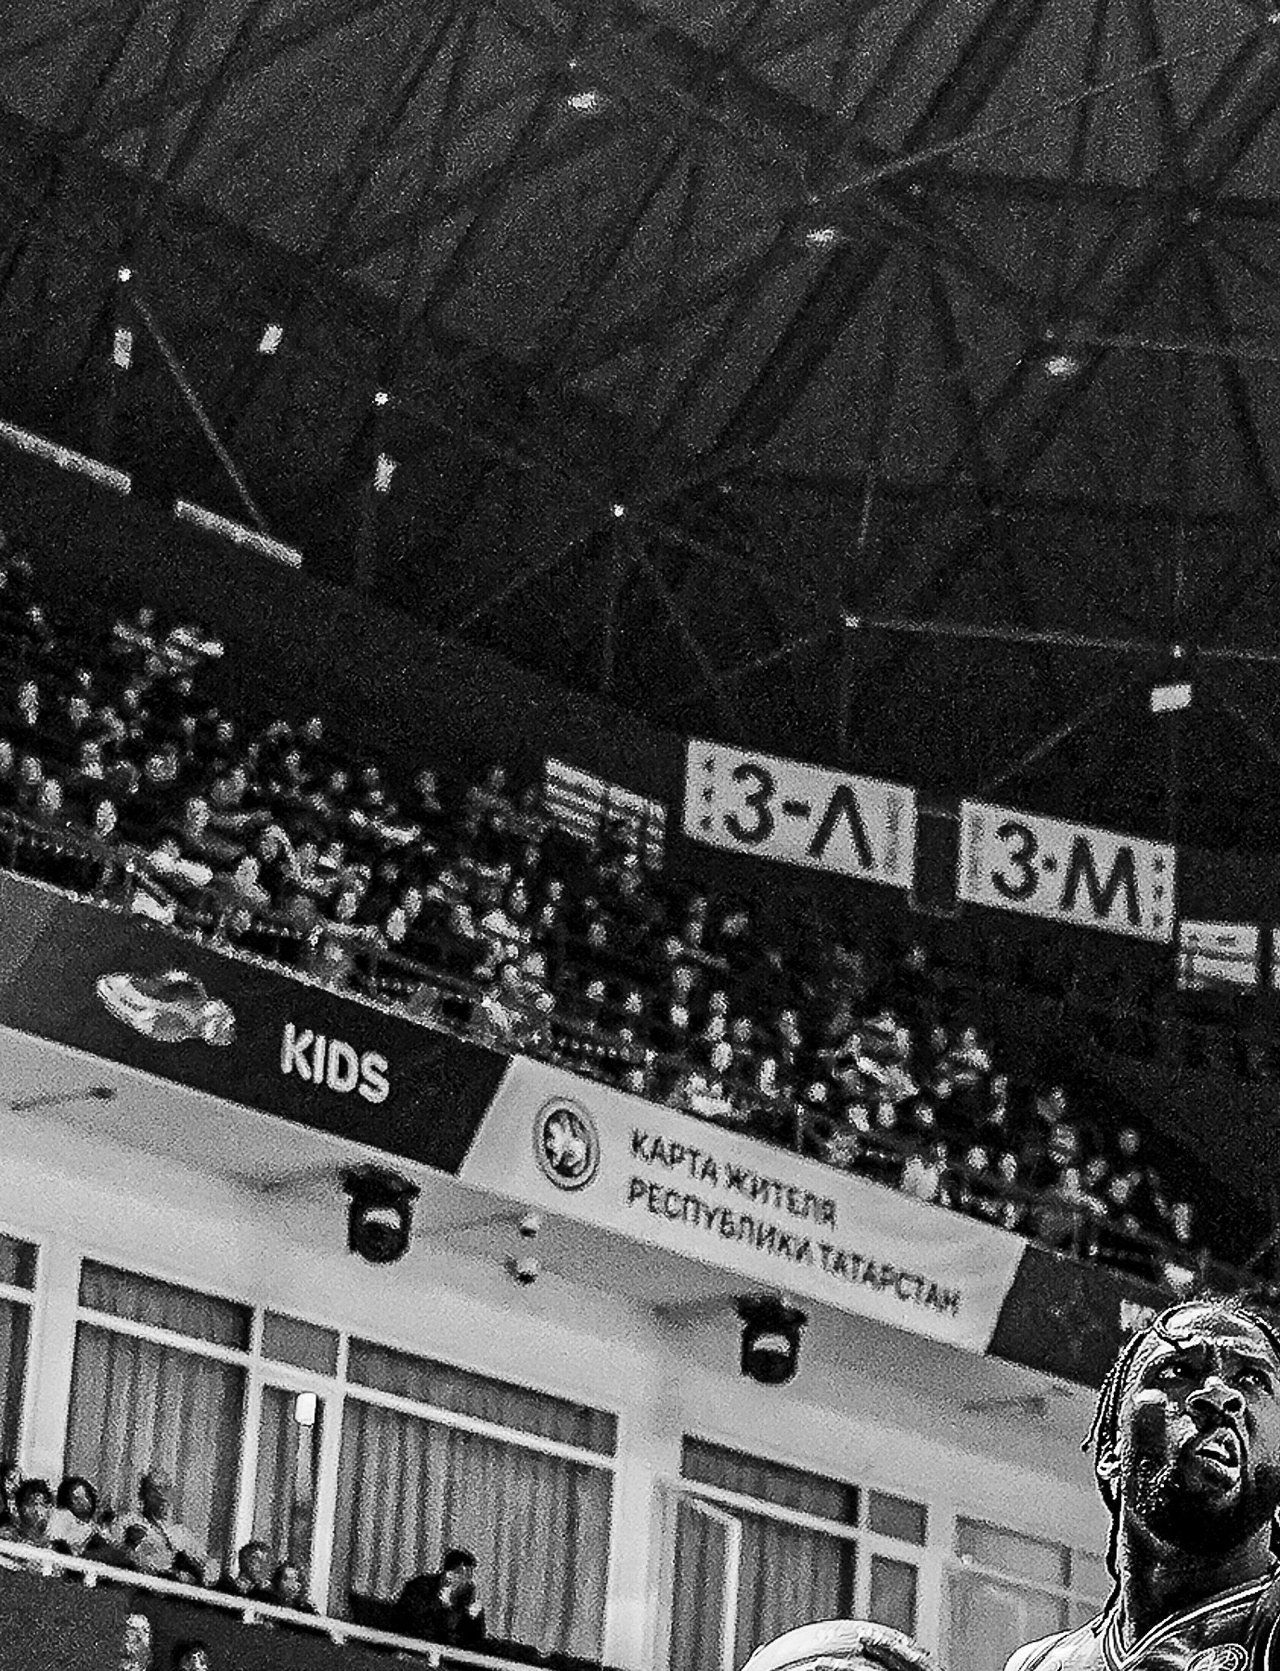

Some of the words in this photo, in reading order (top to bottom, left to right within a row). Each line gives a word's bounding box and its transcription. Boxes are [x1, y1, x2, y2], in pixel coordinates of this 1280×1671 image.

[280, 1022, 390, 1104] KIDS
[630, 1128, 719, 1187] КАРТА
[724, 1163, 837, 1231] ЖИТЕЛЯ
[628, 1176, 814, 1266] РЕСПУБЛИКИ
[816, 1240, 962, 1317] ТАТАРСТАН
